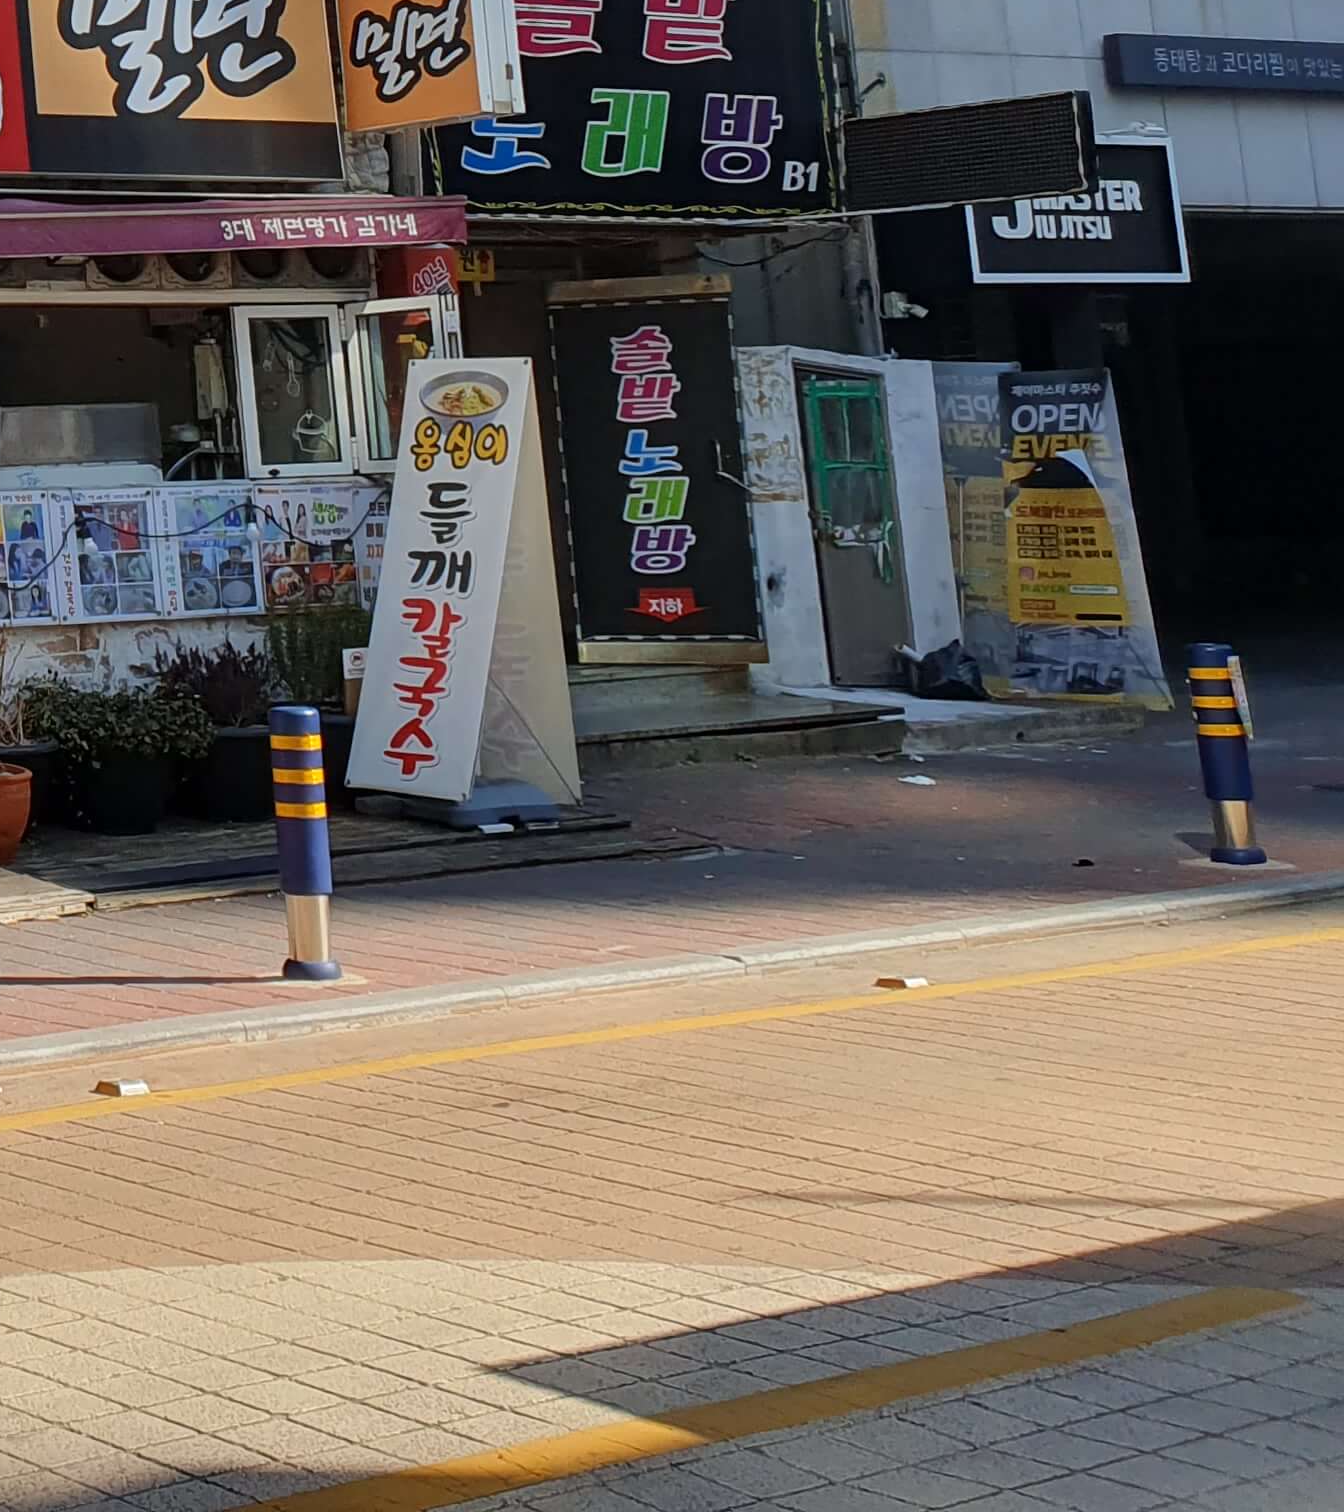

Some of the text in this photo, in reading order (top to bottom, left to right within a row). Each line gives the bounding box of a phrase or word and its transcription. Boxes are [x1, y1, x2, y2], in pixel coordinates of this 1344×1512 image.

[460, 88, 821, 192] 노래방 B1
[219, 213, 419, 242] 3대 제면명가 김가네
[609, 325, 681, 423] 솔밭
[409, 416, 510, 473] 옹심이
[1011, 402, 1102, 433] OPEN
[616, 428, 697, 575] 노래방
[647, 595, 684, 616] 지하
